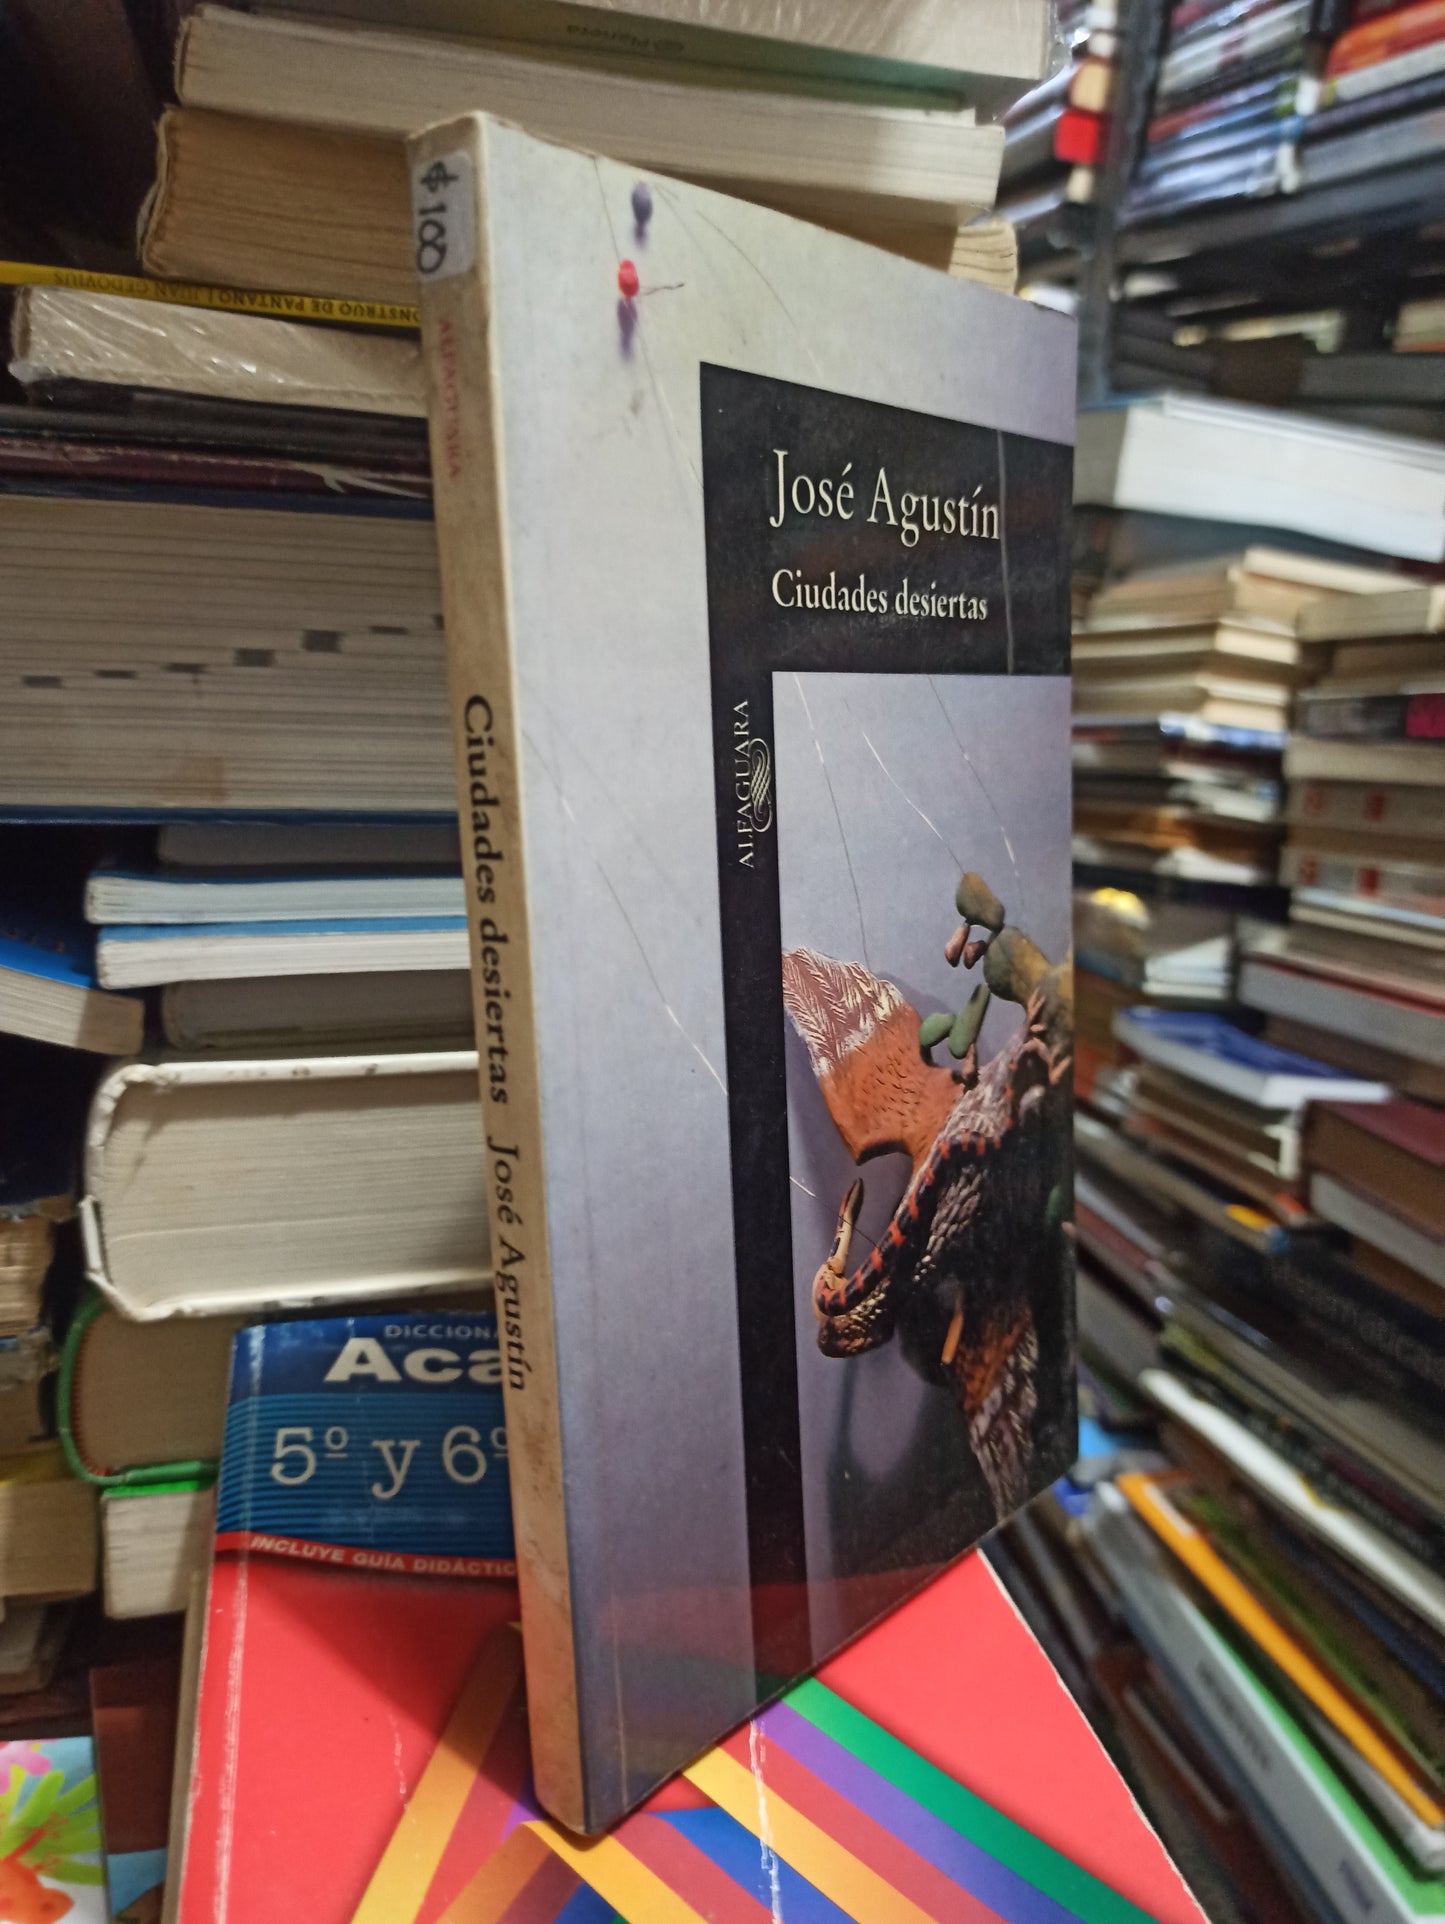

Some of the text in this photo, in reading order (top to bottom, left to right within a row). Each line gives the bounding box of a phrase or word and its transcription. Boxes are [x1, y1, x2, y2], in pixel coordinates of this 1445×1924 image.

[154, 279, 200, 302] JUAN
[219, 290, 304, 311] PANTANO
[311, 300, 333, 314] DE
[769, 448, 1000, 547] José Agustín
[771, 568, 988, 621] Ciudades desiertas
[732, 699, 755, 869] ALFAGUARA
[464, 694, 532, 1392] Ciudades desiertas José Agustín
[371, 1440, 421, 1499] y
[251, 1535, 345, 1562] INCLUYE
[353, 1550, 405, 1572] GUÍA
